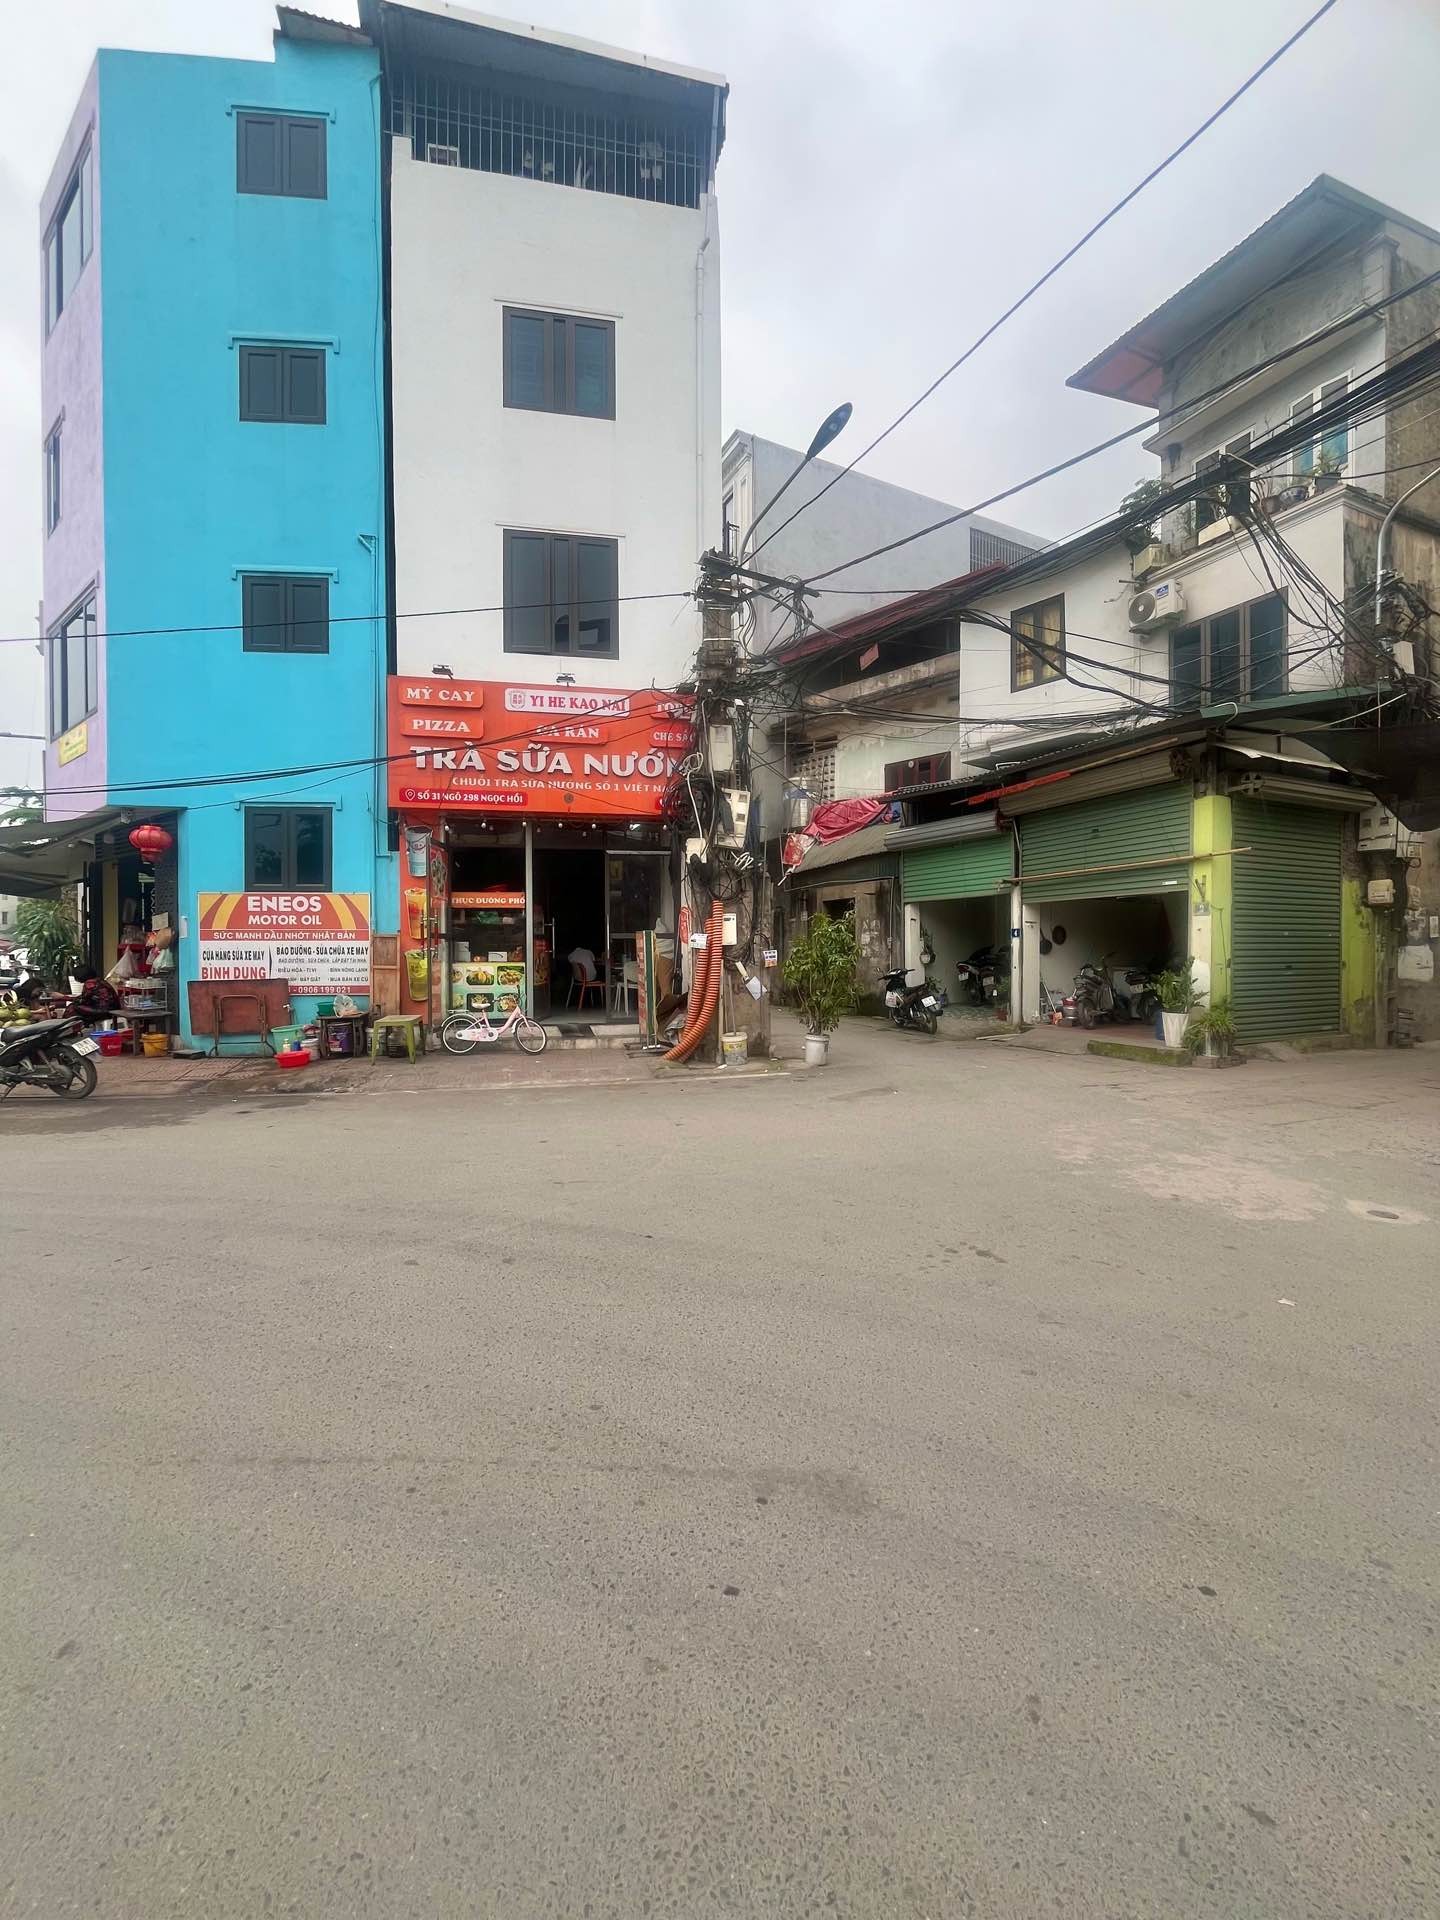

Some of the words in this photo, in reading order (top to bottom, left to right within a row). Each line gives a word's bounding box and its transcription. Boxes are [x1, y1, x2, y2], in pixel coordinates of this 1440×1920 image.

[406, 686, 433, 700] MỲ
[438, 689, 475, 702] CAY
[530, 695, 544, 708] YI
[548, 696, 566, 709] HE
[569, 697, 598, 710] KAO
[602, 698, 626, 712] NAI
[412, 719, 471, 733] PIZZA
[564, 724, 600, 738] RÁN
[409, 741, 486, 771] TRÀ
[496, 743, 573, 774] SỮA
[452, 775, 491, 787] CHUỖI
[494, 776, 519, 788] TRÀ
[521, 777, 545, 789] SỮA
[548, 778, 592, 790] NƯỚNG
[595, 780, 611, 791] SỐ
[613, 782, 620, 791] 1
[623, 781, 649, 794] VIỆT
[417, 789, 430, 800] SỐ
[442, 791, 461, 801] NGÕ
[463, 793, 479, 802] 298
[480, 794, 505, 804] NGỌC
[506, 792, 523, 803] HỒI
[247, 896, 322, 913] ENEOS
[248, 915, 297, 926] MOTOR
[301, 915, 322, 926] OIL
[213, 930, 234, 940] SỨC
[235, 931, 262, 941] MẠNH
[264, 929, 283, 940] DẦU
[285, 930, 310, 940] NHỚT
[312, 930, 335, 941] NHẬT
[337, 930, 356, 940] BẢN
[244, 950, 252, 961] XE
[346, 946, 355, 956] XE
[201, 962, 230, 980] BÌNH
[298, 986, 320, 994] 0906
[320, 986, 335, 994] 199
[336, 986, 351, 994] 021
